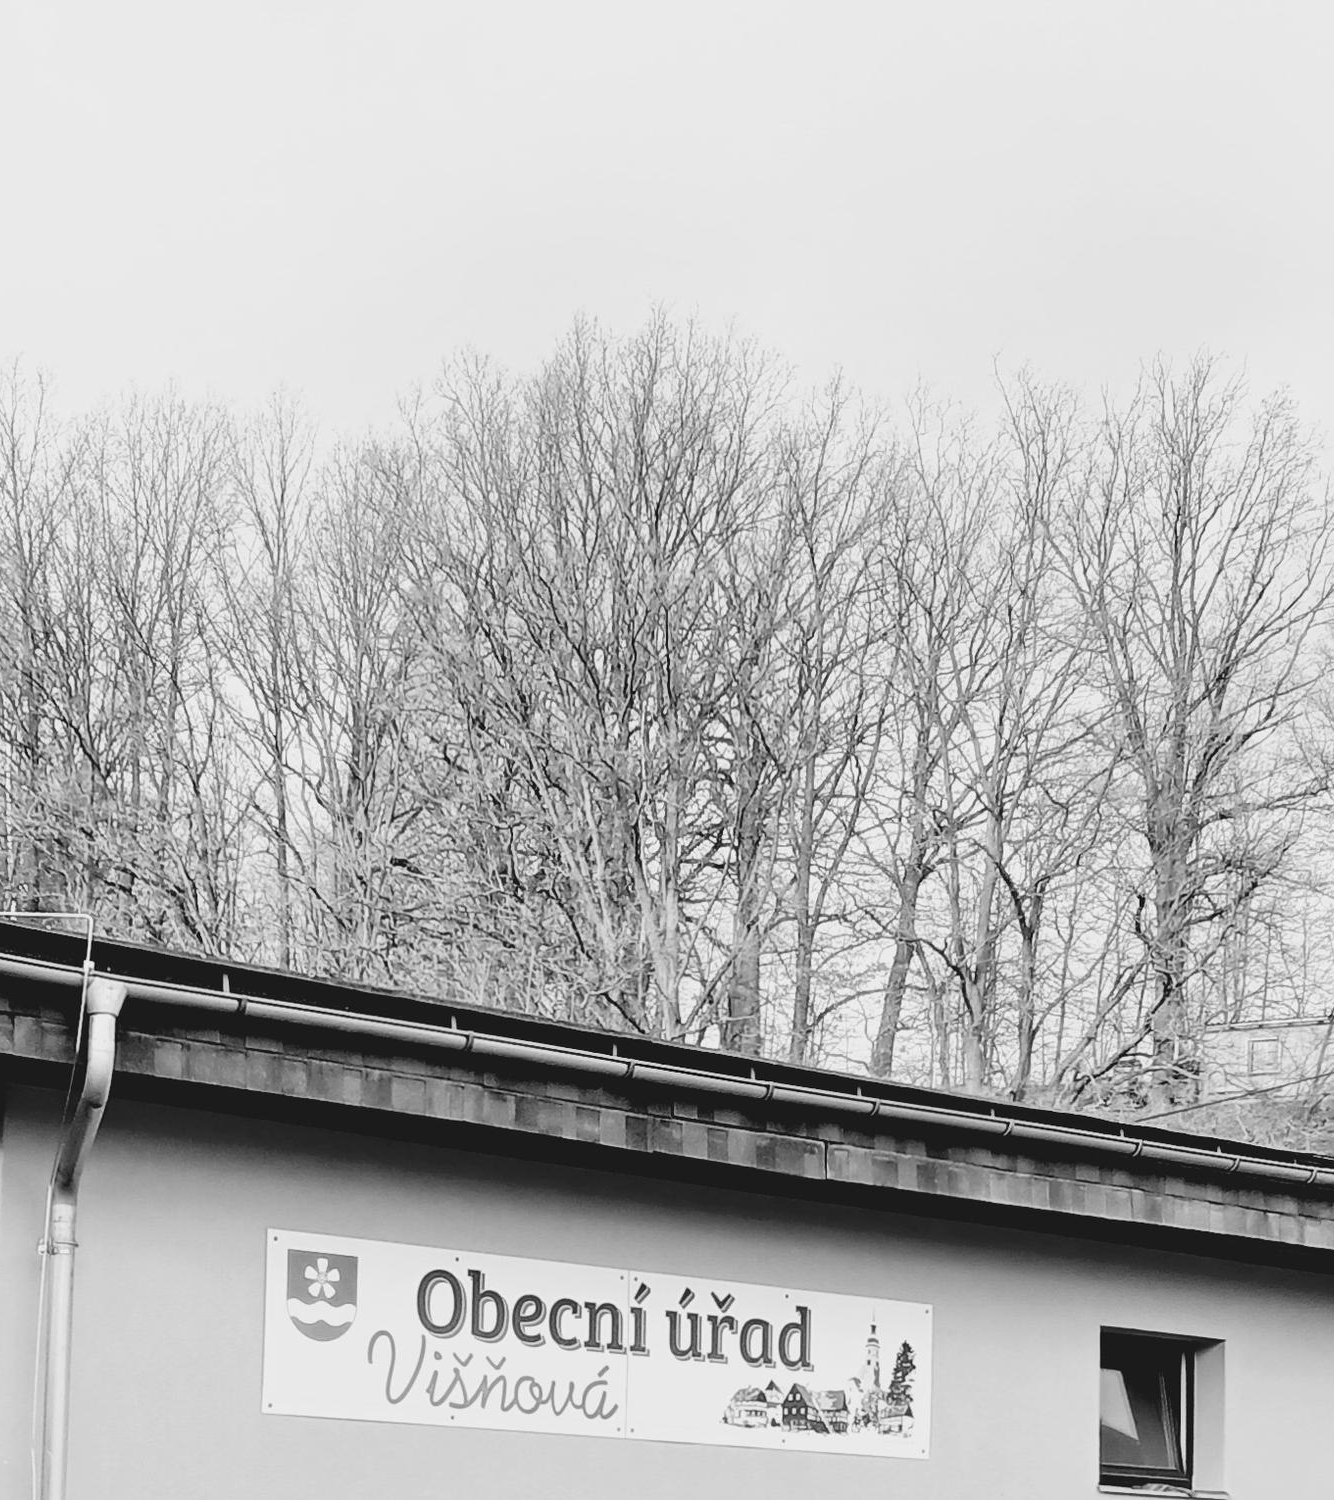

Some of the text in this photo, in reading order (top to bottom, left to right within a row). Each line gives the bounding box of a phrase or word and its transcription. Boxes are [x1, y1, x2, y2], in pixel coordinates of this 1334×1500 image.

[416, 1269, 815, 1370] Obecní úřad
[368, 1329, 618, 1420] Višňová
